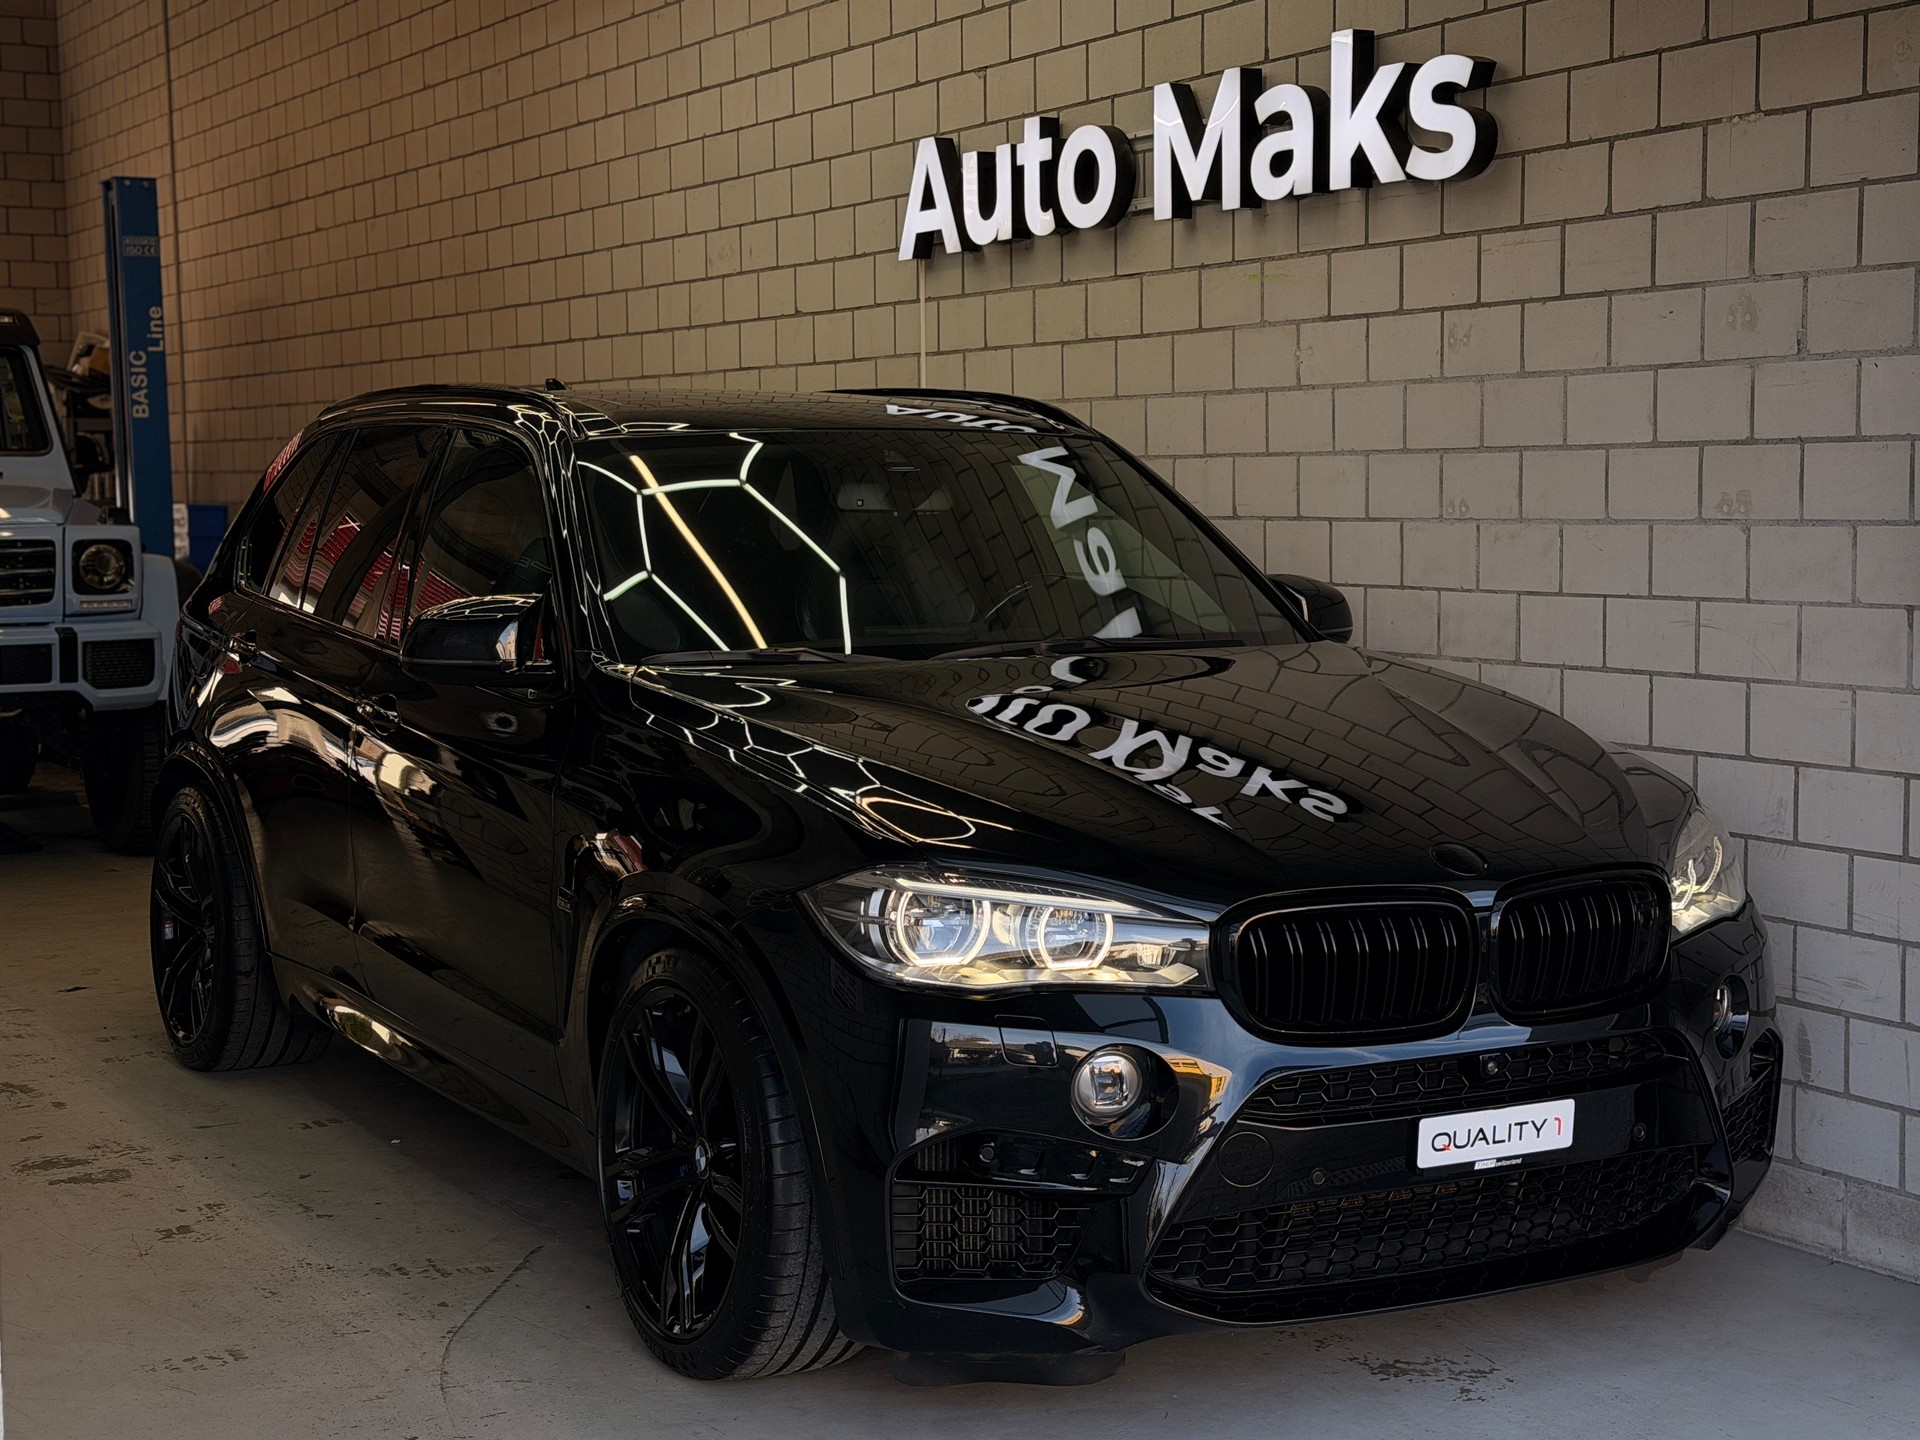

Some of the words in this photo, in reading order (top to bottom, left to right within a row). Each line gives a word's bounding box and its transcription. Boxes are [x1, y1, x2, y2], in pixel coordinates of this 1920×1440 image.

[898, 115, 1118, 261] Auto
[1153, 29, 1478, 221] Maks
[147, 306, 163, 352] Line
[129, 350, 149, 418] BASIC
[1431, 1118, 1548, 1152] QUALITY
[1553, 1116, 1562, 1136] 1
